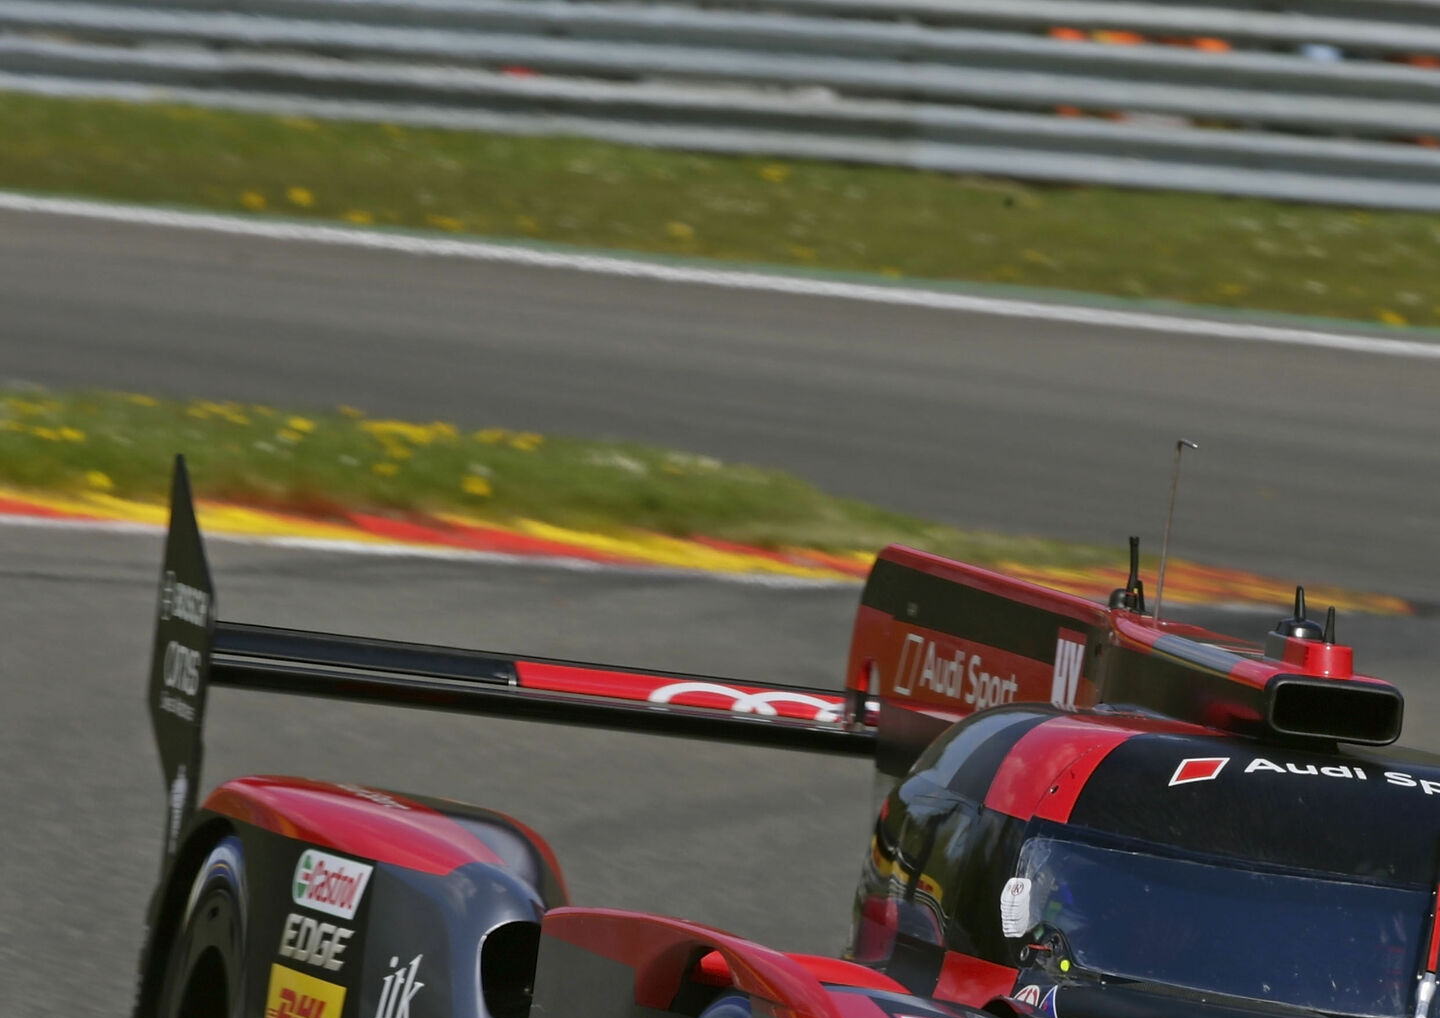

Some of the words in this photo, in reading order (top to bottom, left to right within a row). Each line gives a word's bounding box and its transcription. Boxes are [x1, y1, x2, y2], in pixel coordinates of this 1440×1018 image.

[920, 641, 966, 699] Audi
[965, 655, 1018, 712] Sport
[1244, 757, 1368, 781] Audi
[304, 859, 363, 910] Castrol
[280, 913, 354, 971] EDGE
